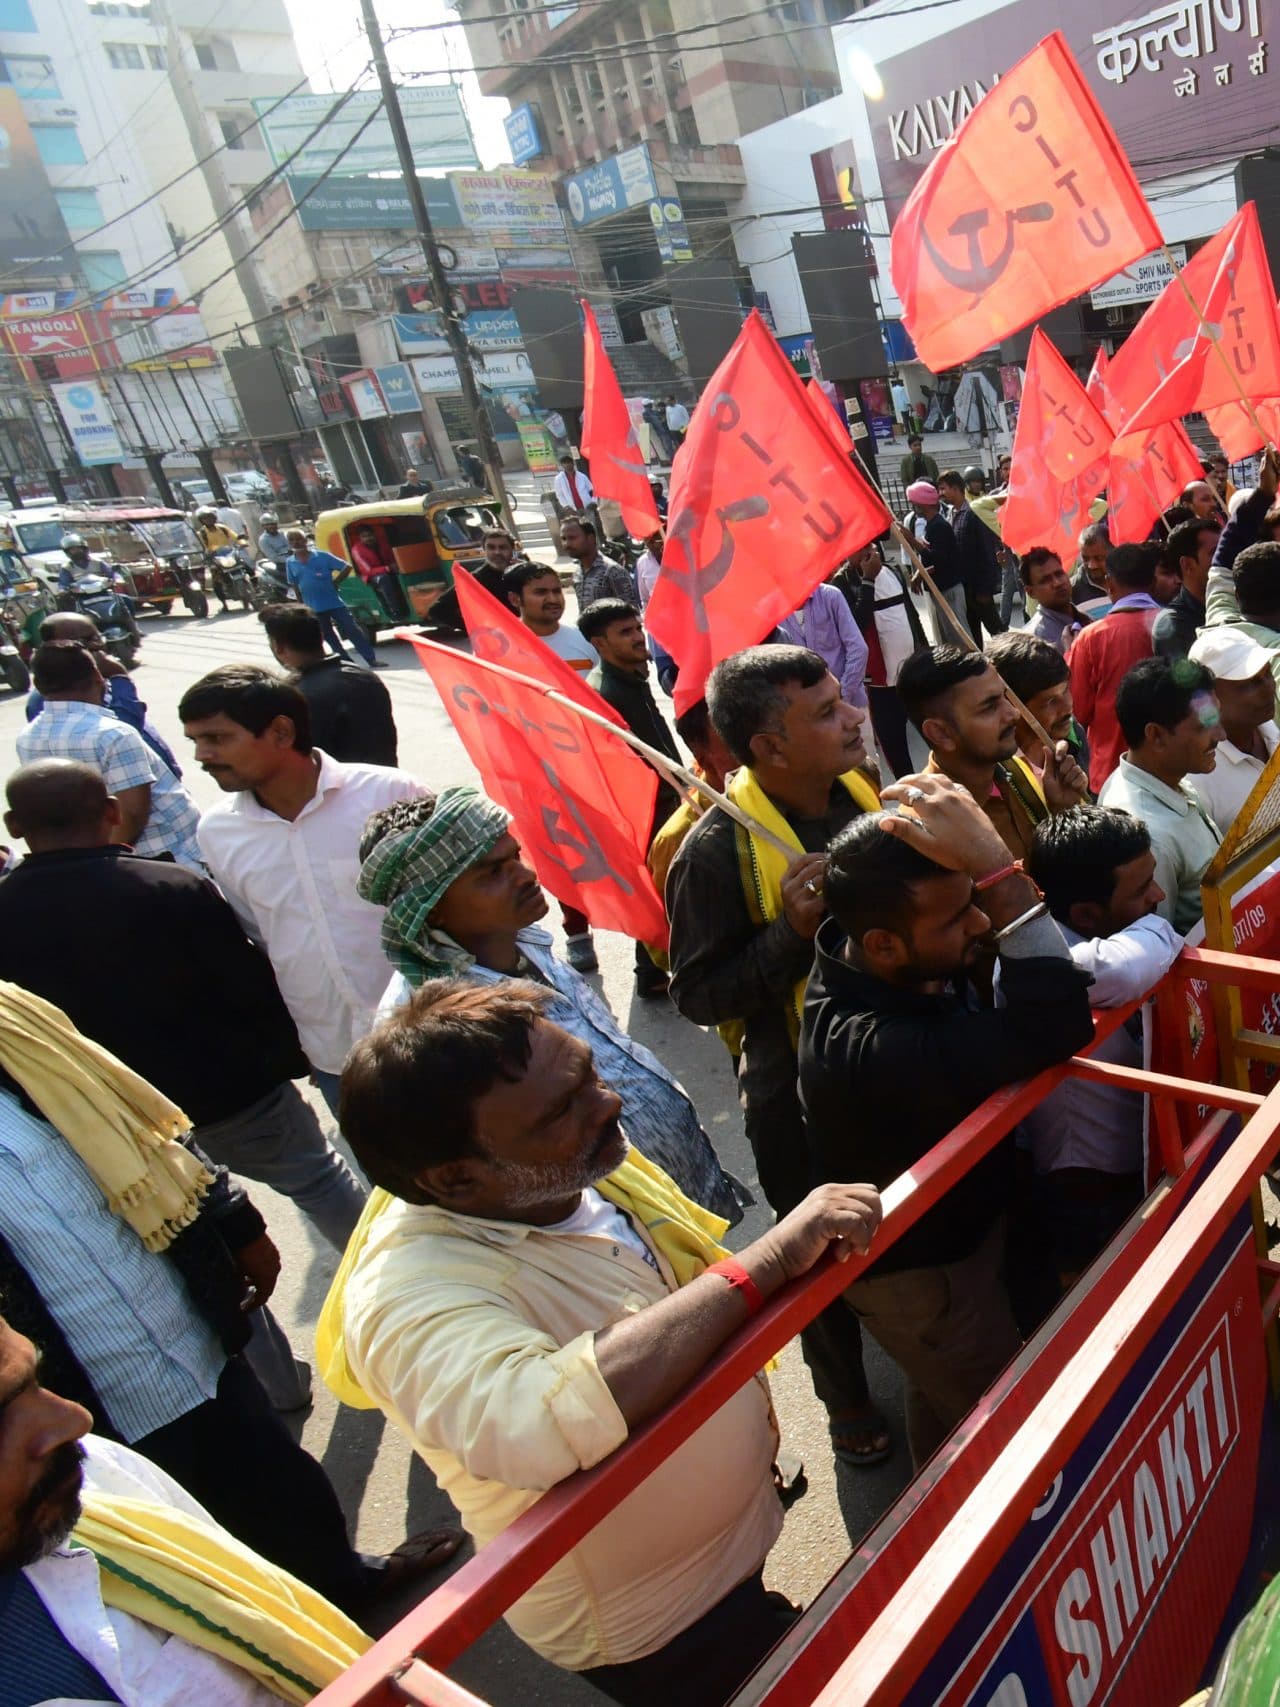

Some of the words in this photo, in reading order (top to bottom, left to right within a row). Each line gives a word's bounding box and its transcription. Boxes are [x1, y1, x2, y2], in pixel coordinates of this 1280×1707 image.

[887, 73, 1002, 161] KALYA
[1138, 263, 1156, 280] SHIV
[1135, 280, 1161, 295] SPORTS
[8, 318, 79, 336] RANGOLI
[421, 366, 459, 380] CHAMP
[1054, 1346, 1233, 1707] SHAKTI
